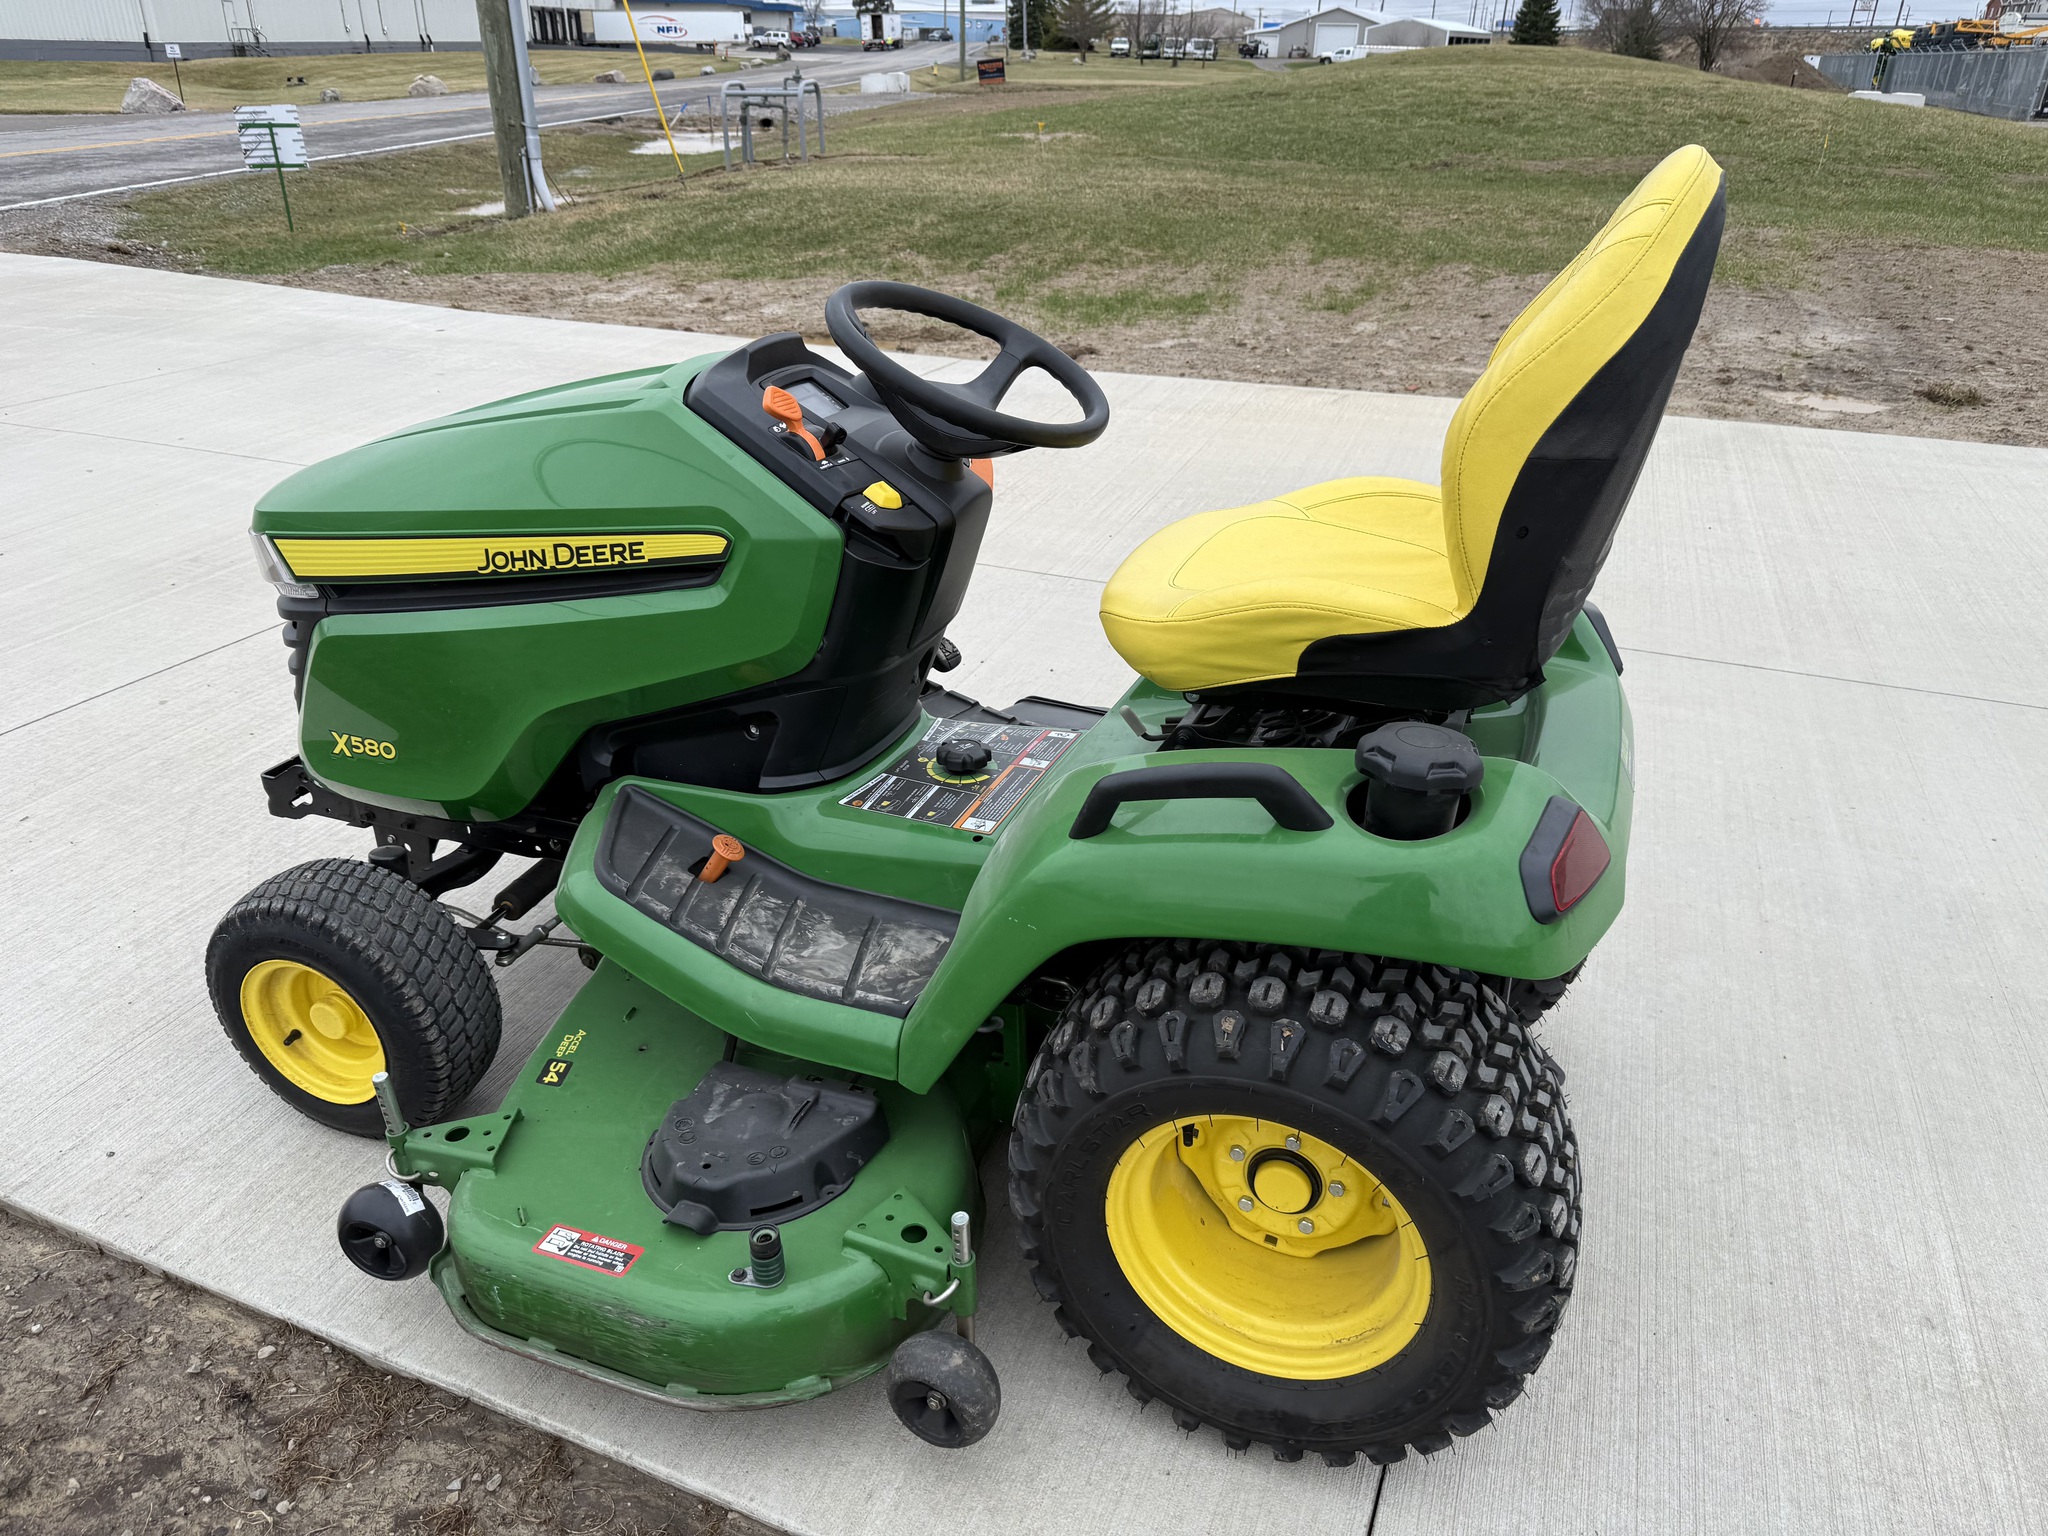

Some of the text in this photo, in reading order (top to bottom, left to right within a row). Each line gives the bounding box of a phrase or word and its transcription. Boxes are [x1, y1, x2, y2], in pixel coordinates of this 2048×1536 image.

[656, 26, 678, 34] NFI
[477, 541, 647, 572] JOHN DEERE
[329, 730, 397, 760] X580
[555, 1034, 575, 1058] DEEP
[565, 1028, 587, 1055] ACCEL
[542, 1061, 567, 1083] 54
[581, 1241, 625, 1257] ROTATING BLADE
[599, 1238, 628, 1250] DANGER
